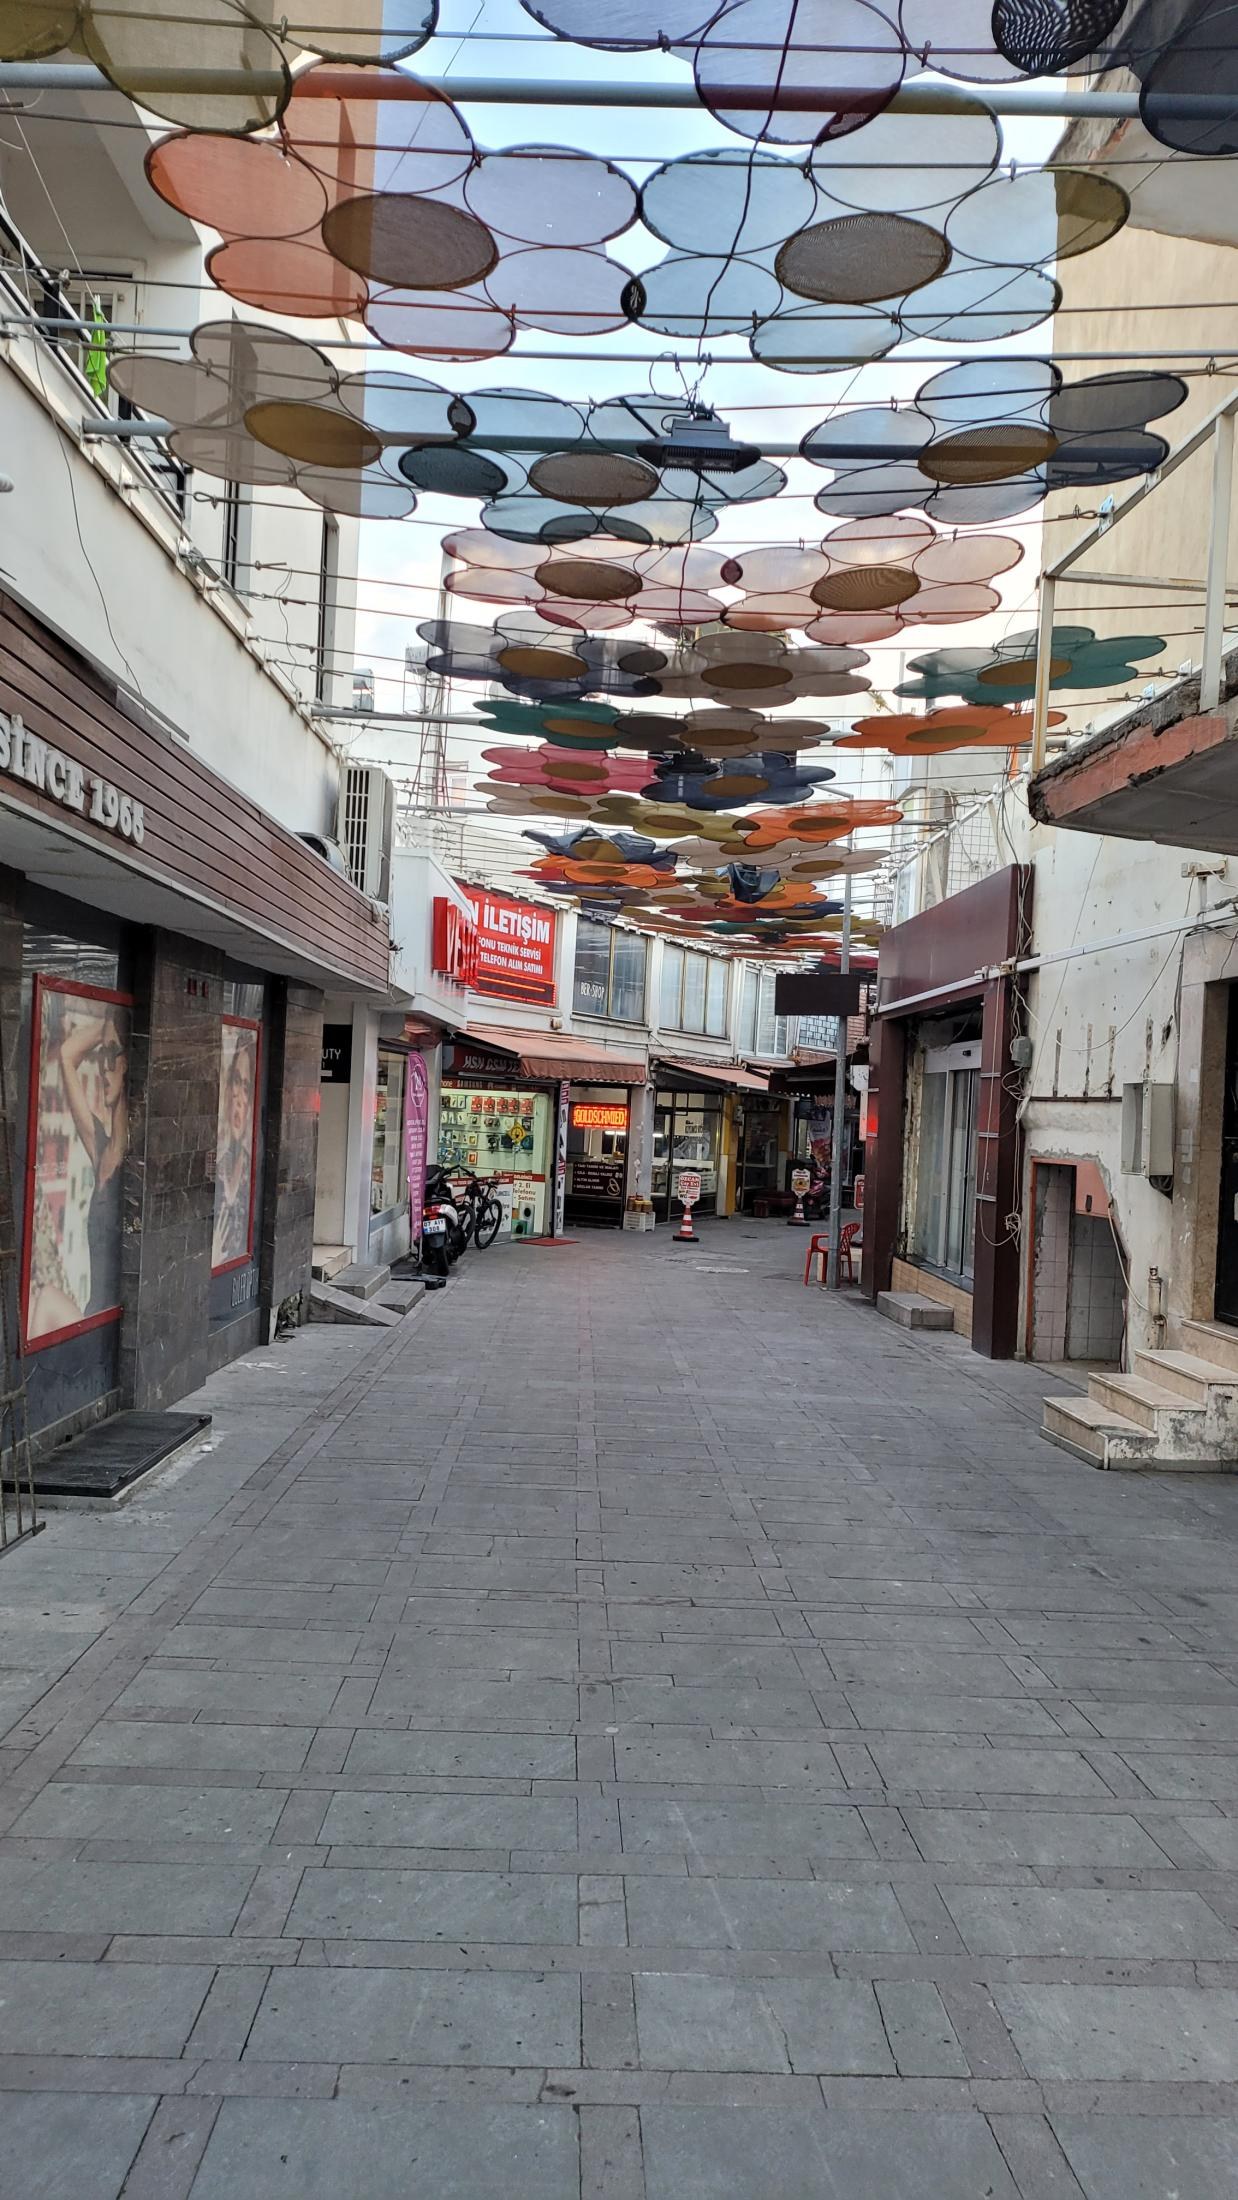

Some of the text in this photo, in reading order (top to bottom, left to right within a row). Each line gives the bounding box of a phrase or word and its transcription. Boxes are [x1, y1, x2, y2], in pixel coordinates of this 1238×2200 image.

[483, 898, 551, 945] İLETİŞİM
[497, 941, 519, 956] TEKNİK
[519, 947, 541, 960] SERVİSİ
[480, 952, 543, 974] TELEFON ALIM SATIMI
[462, 1055, 485, 1070] HSN
[575, 1109, 625, 1125] GOLDSCHMIED
